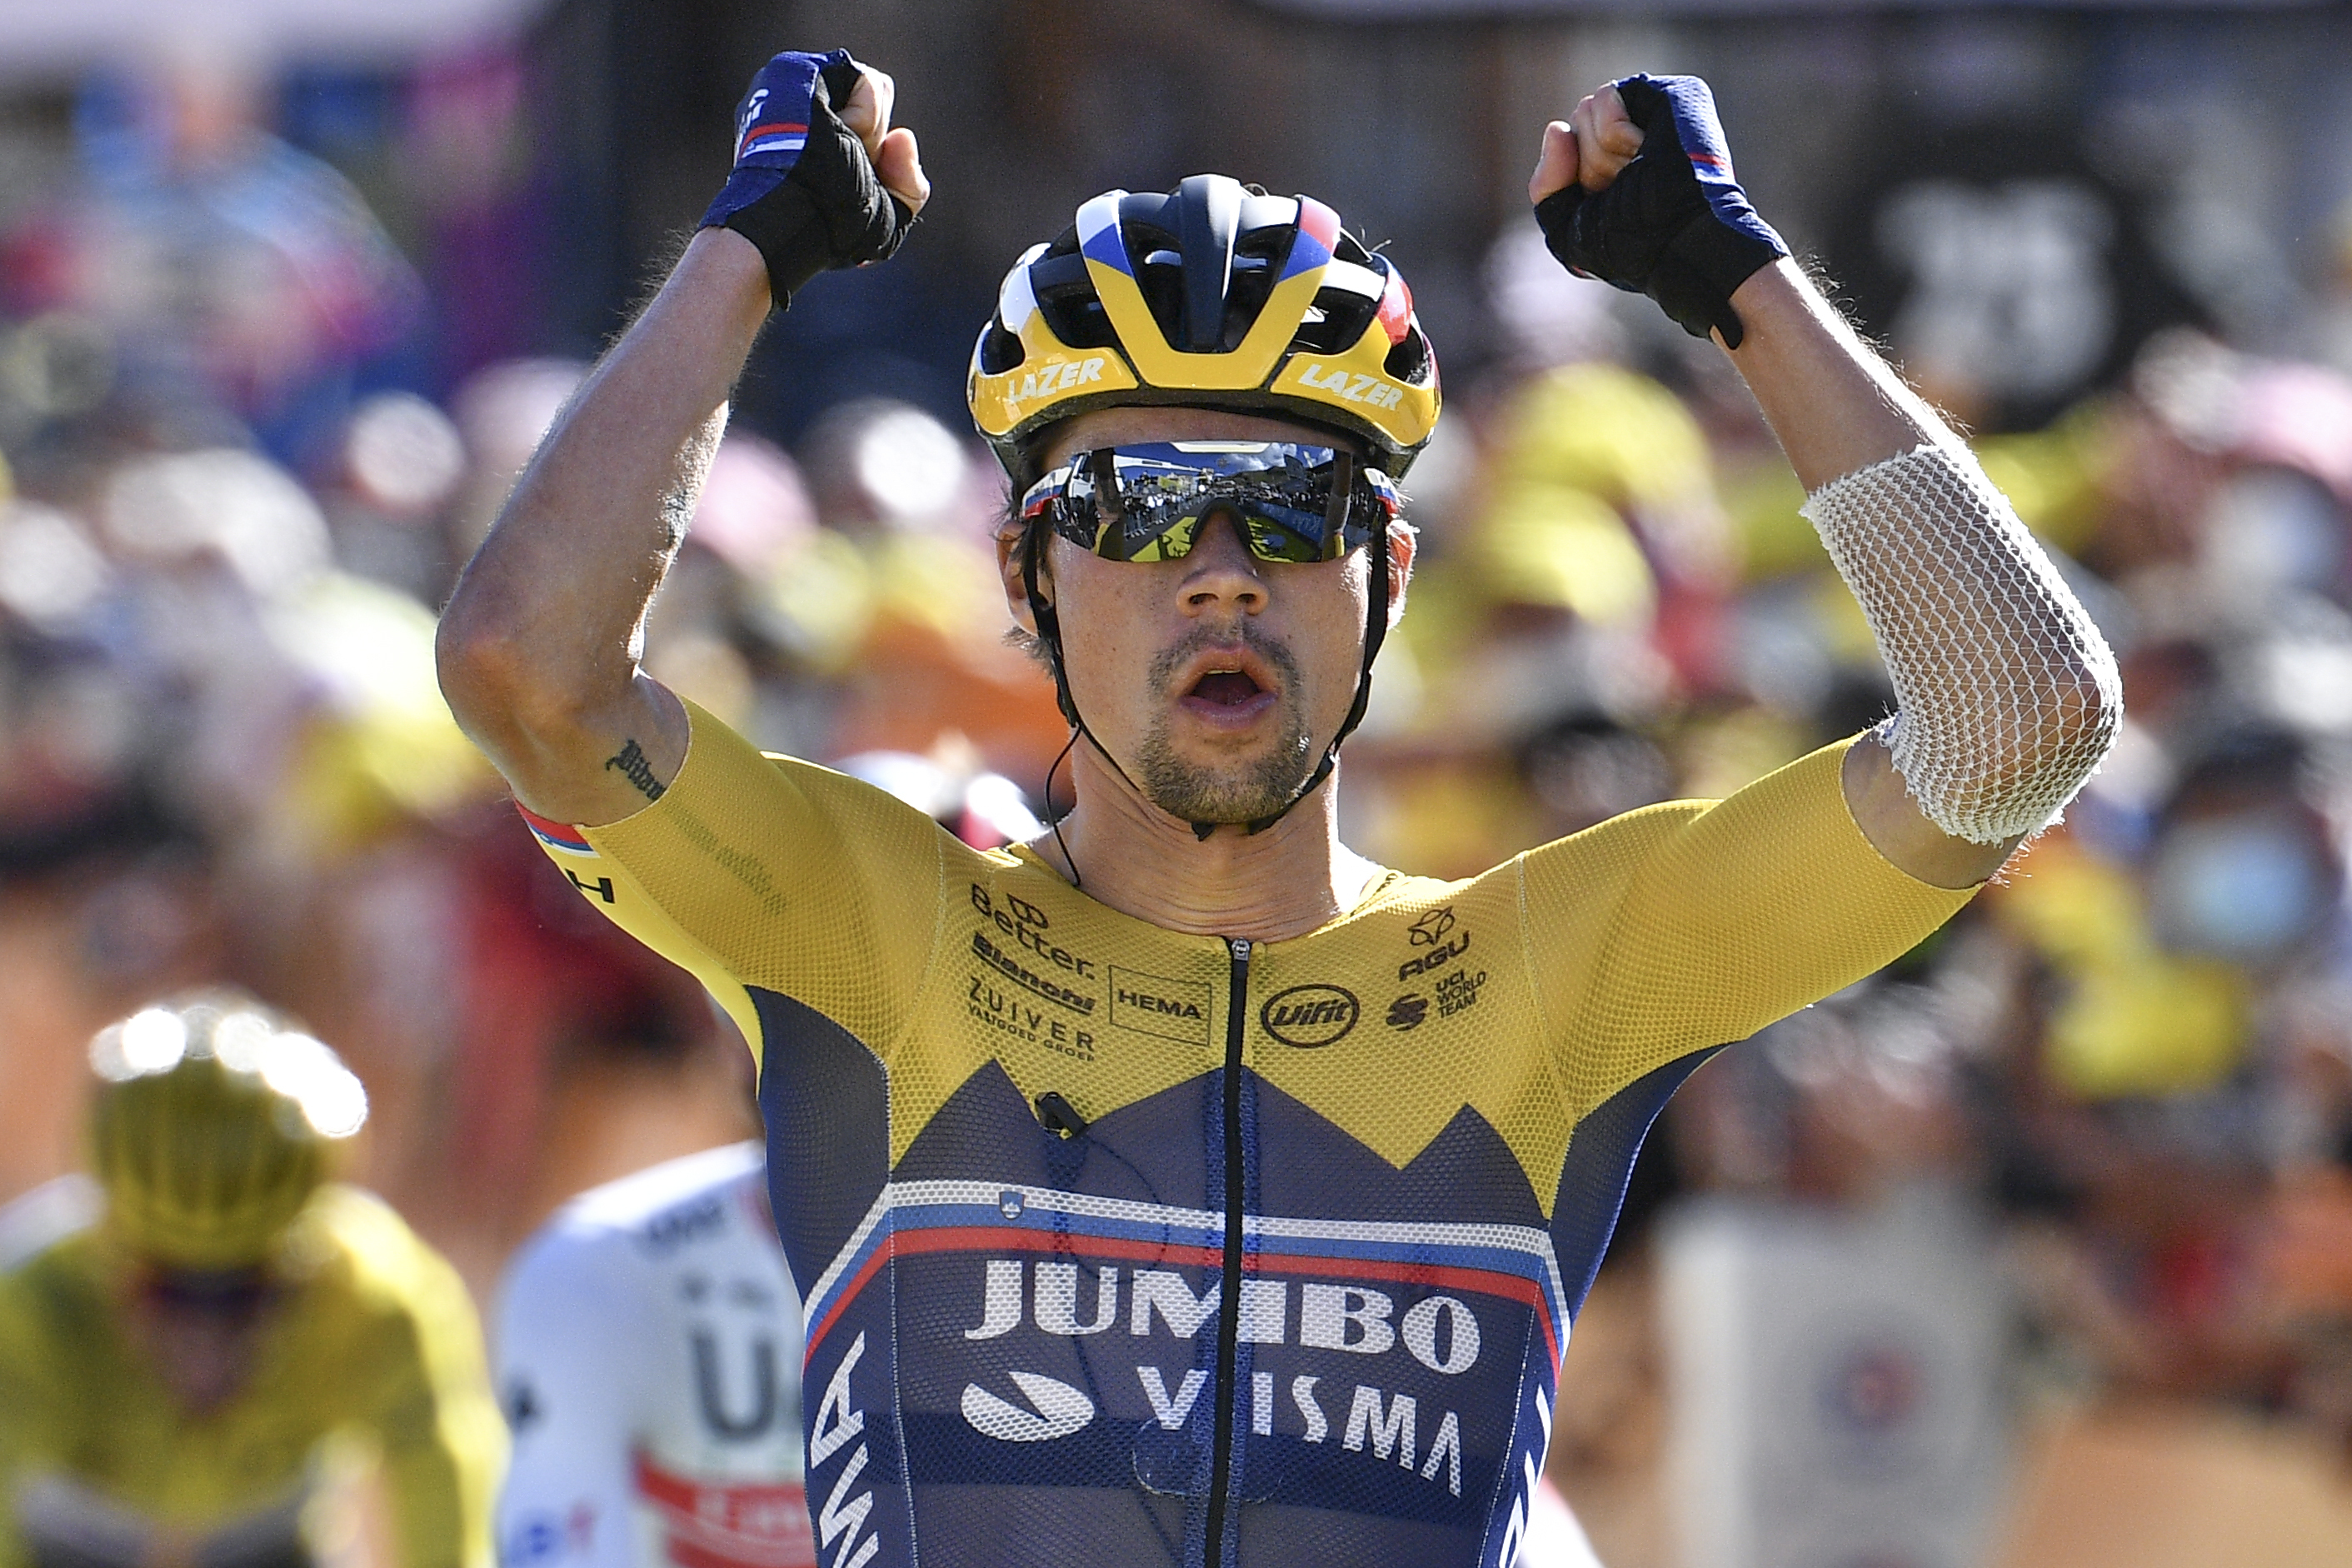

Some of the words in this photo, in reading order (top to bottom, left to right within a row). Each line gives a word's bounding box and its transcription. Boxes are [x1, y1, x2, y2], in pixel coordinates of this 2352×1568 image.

[1008, 357, 1105, 404] LAZER
[1297, 363, 1404, 411] LAZER
[1399, 931, 1470, 981] AGU
[1436, 969, 1465, 991] UCI
[1436, 971, 1486, 1005] WORLD
[970, 976, 1095, 1051] ZUIVER
[1118, 989, 1201, 1020] HEMA
[1438, 991, 1476, 1018] TEAM
[1043, 1039, 1095, 1061] GROEP
[964, 1259, 1482, 1375] JUMBO
[1136, 1366, 1462, 1499] VISMA
